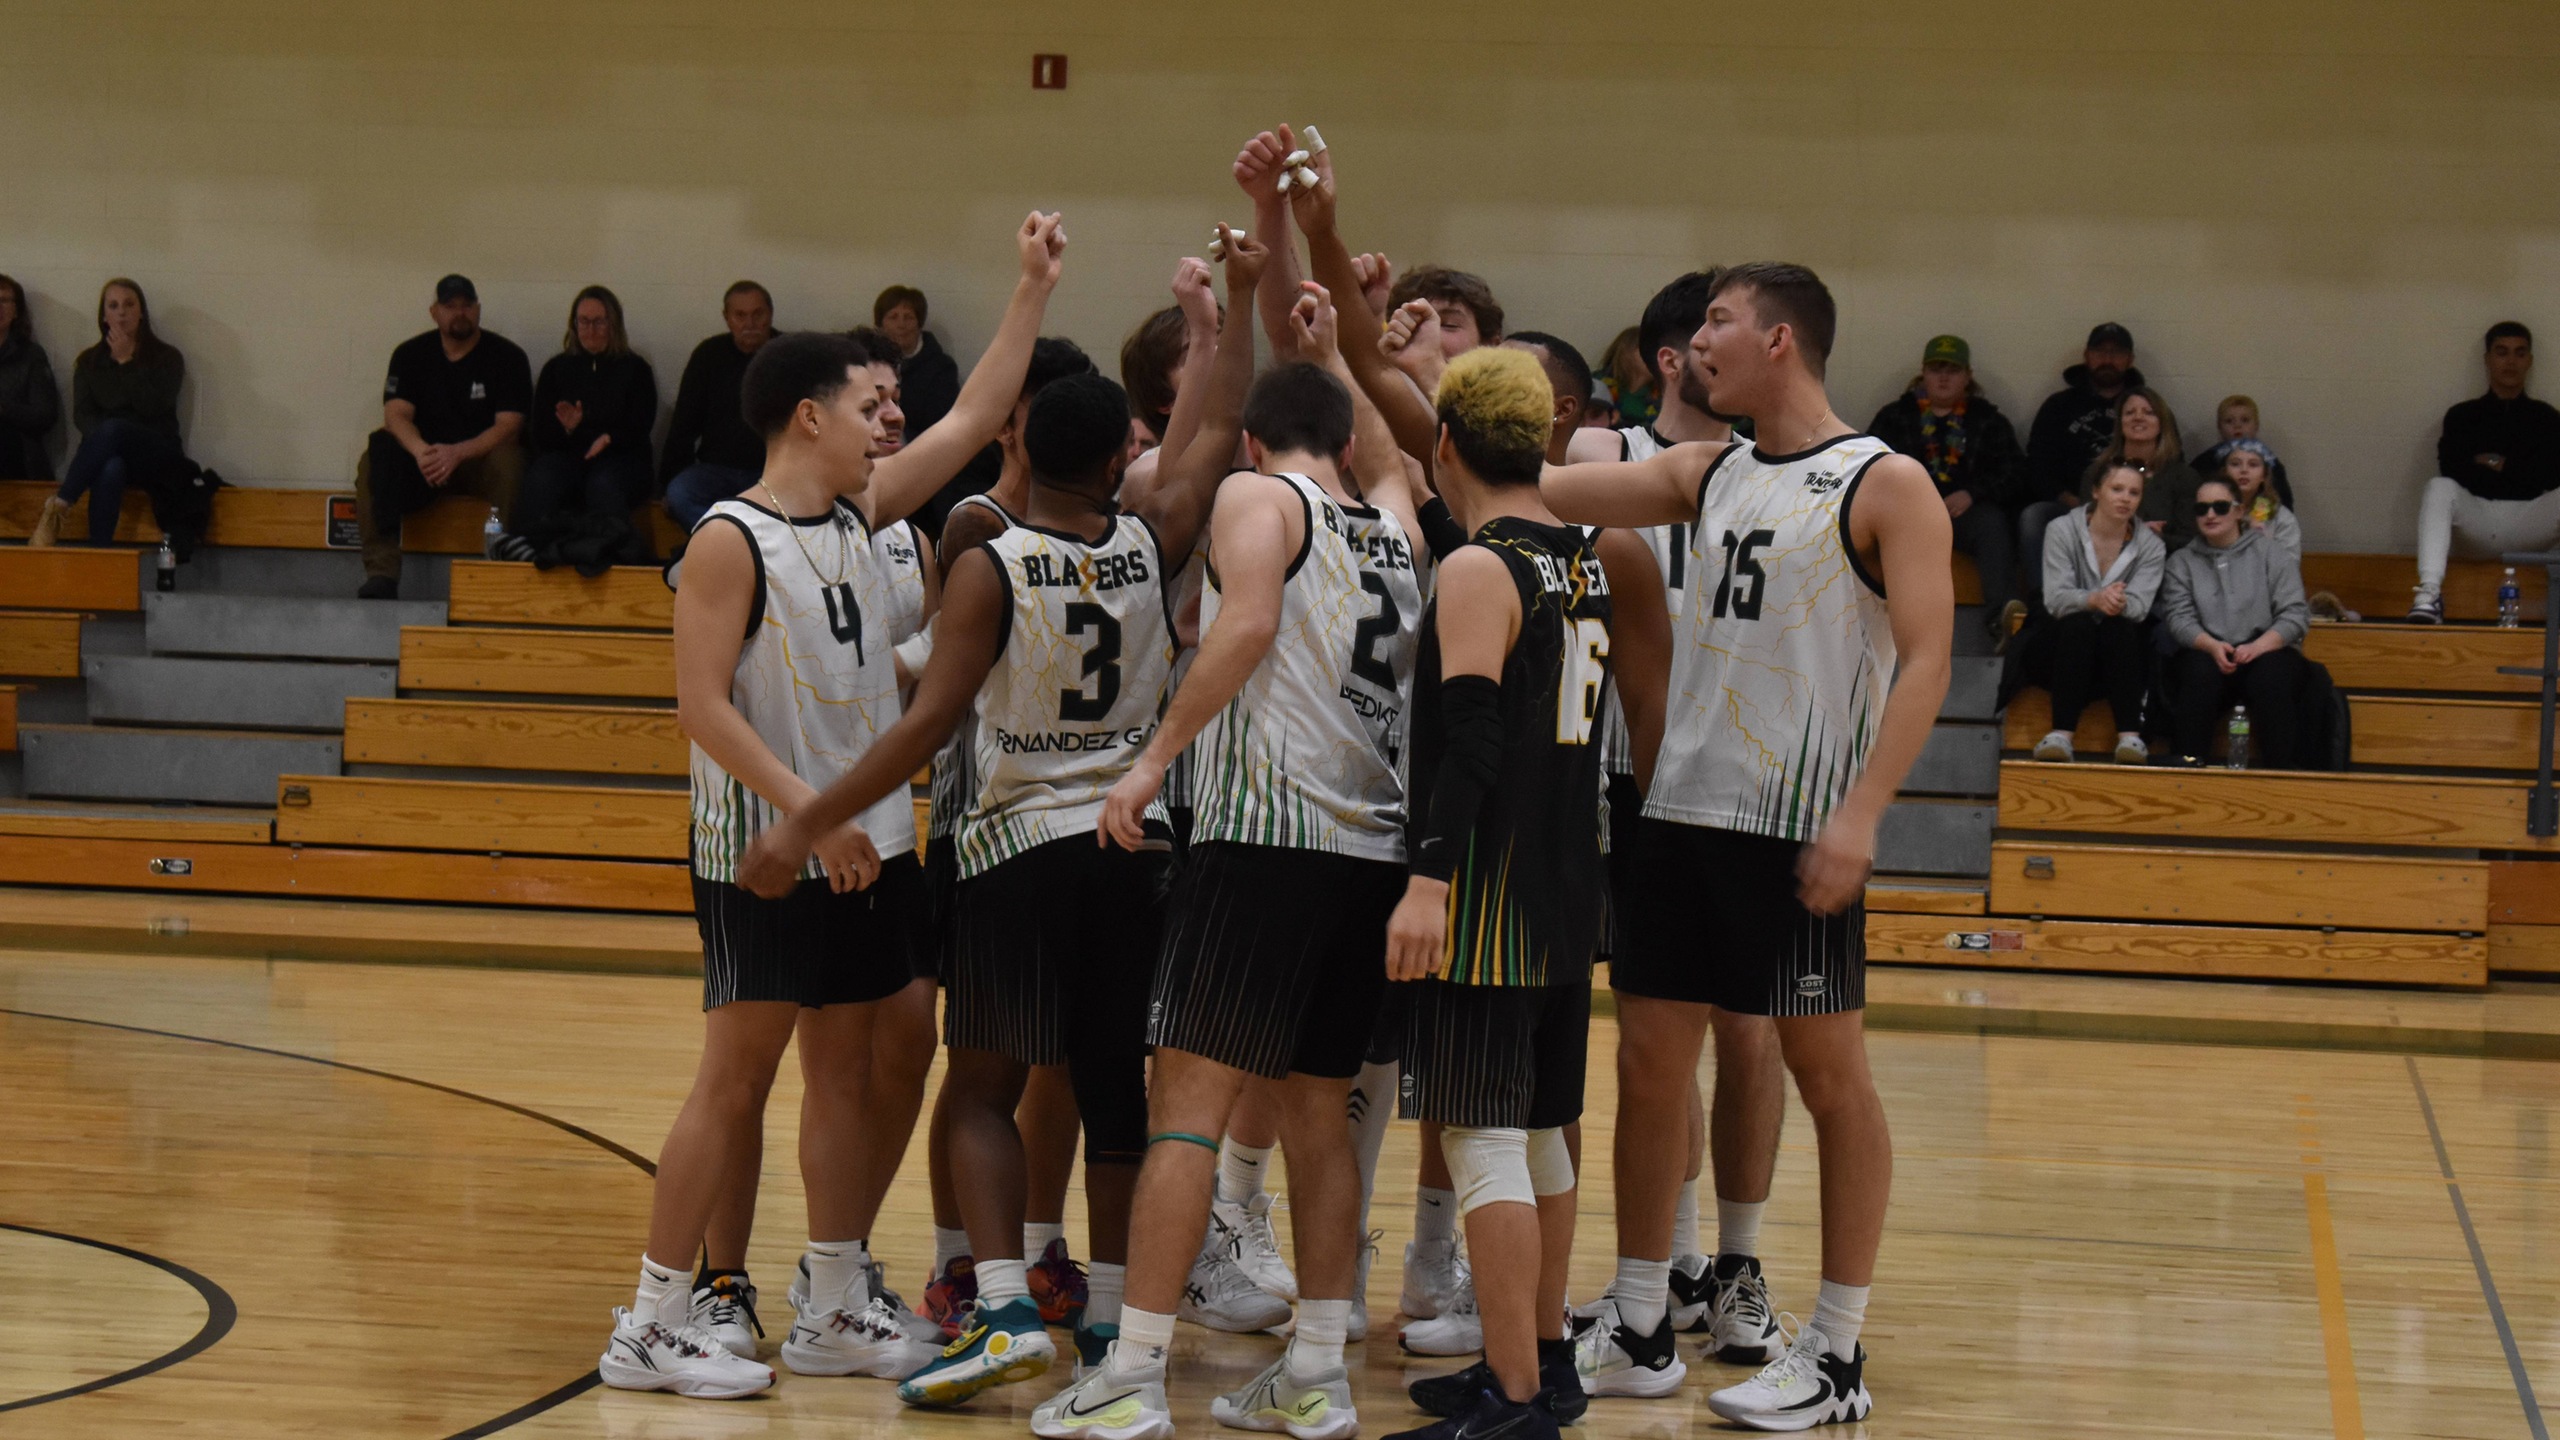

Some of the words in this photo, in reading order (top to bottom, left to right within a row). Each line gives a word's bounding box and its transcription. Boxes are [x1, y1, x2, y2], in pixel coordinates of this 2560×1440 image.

[821, 581, 865, 668] 4
[1712, 529, 1776, 621] 15
[1059, 602, 1121, 721] 3
[1350, 570, 1400, 694] 2
[1556, 617, 1610, 745] 16
[1800, 980, 1825, 988] LOST
